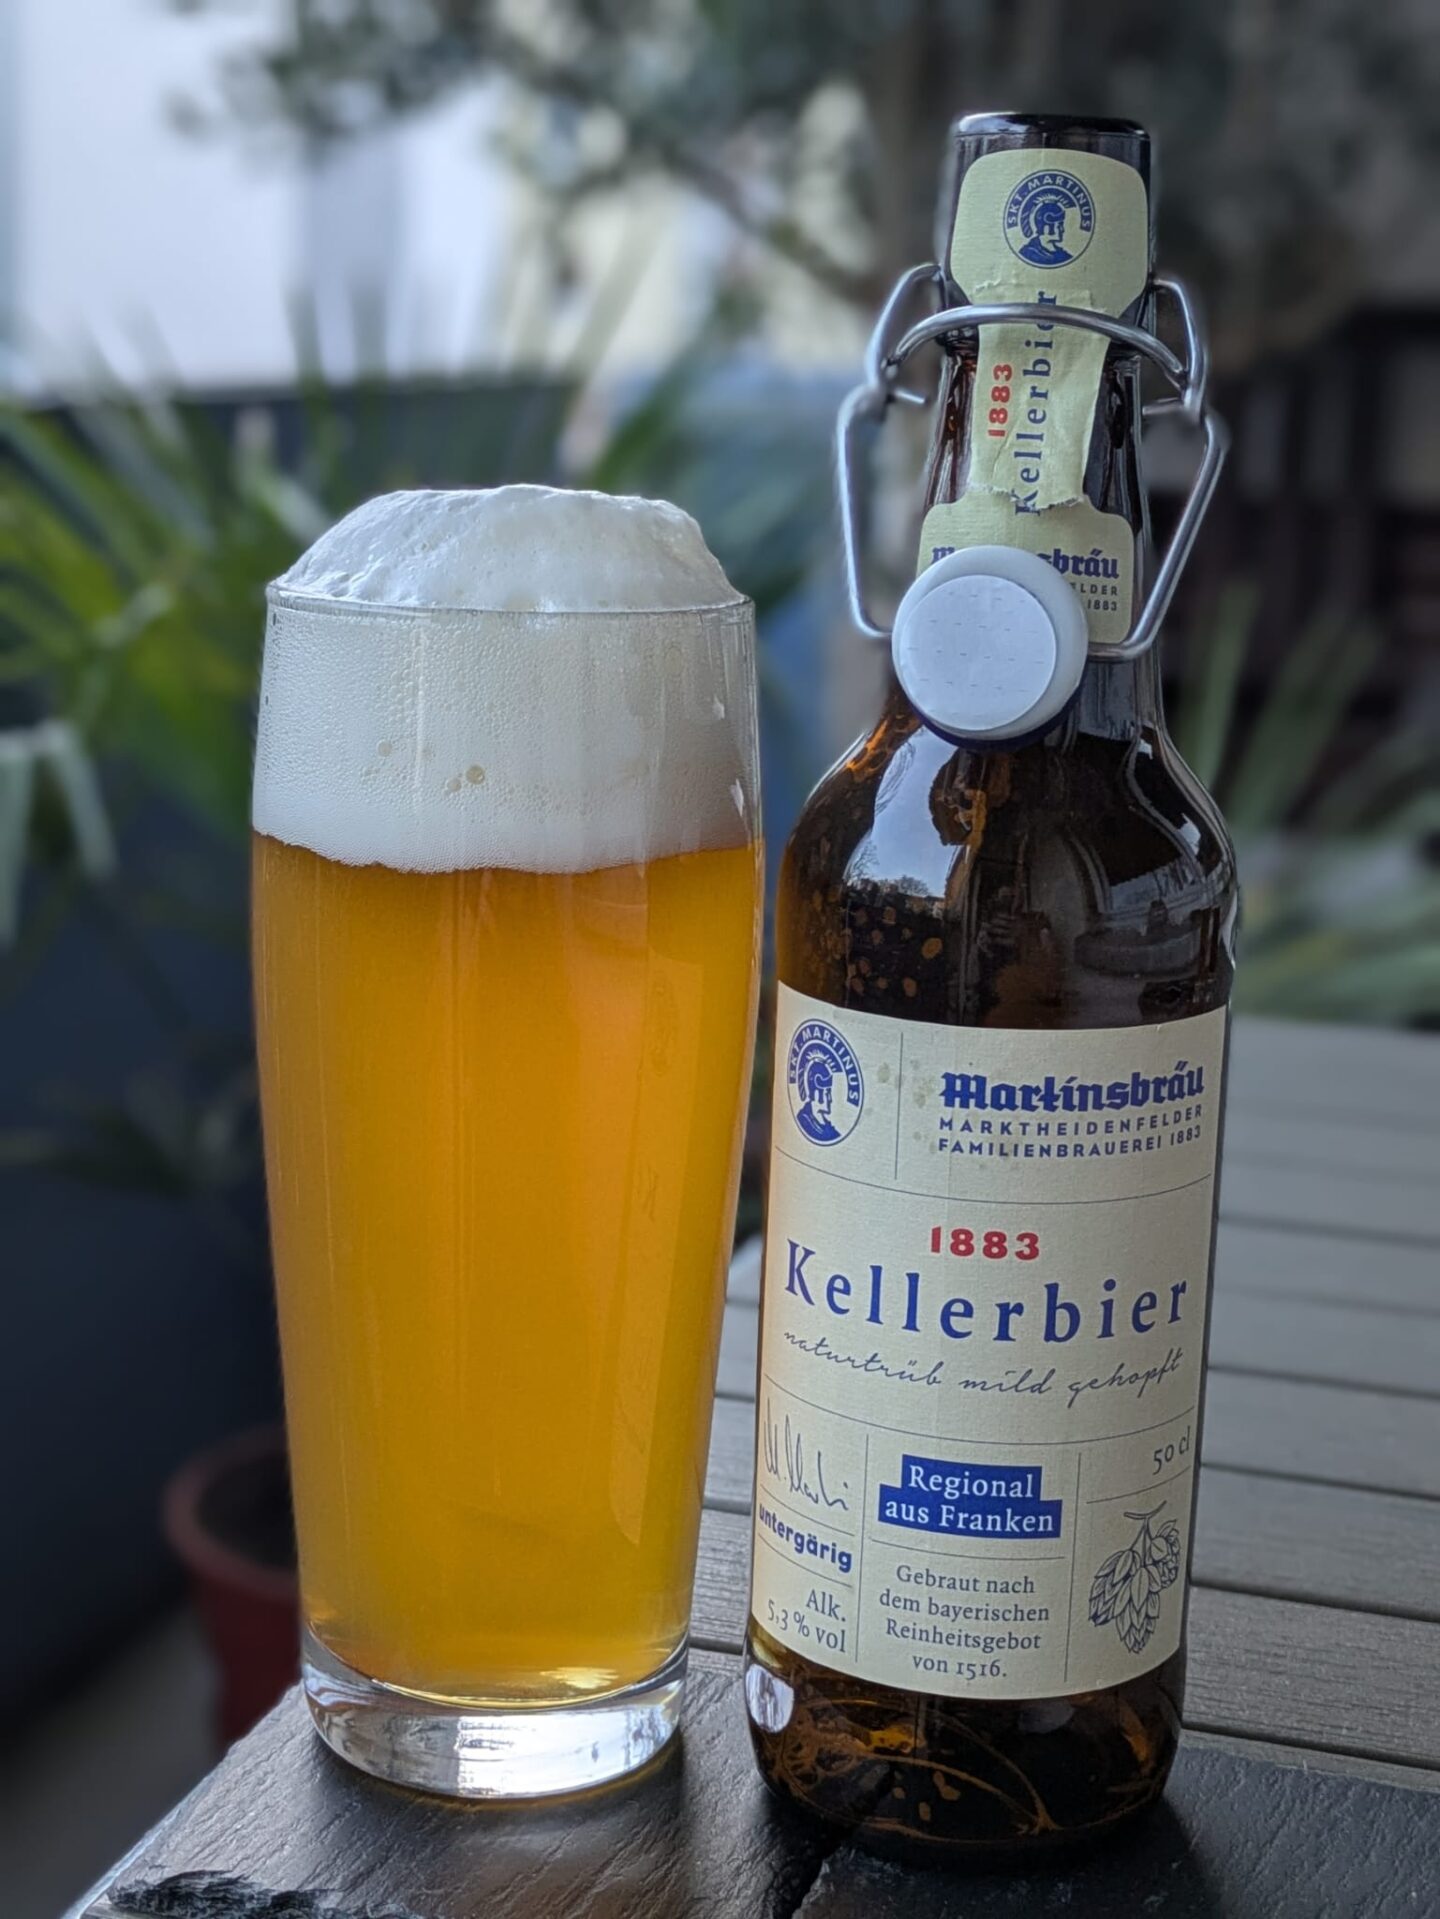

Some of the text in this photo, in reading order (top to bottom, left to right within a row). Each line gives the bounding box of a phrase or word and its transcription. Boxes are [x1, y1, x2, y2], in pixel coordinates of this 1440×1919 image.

[1028, 175, 1090, 227] MARTINUS
[988, 364, 1013, 437] 1883
[1087, 599, 1118, 612] 1883
[802, 1026, 859, 1100] MARTINUS
[939, 1061, 1205, 1113] Martinsbräu
[939, 1104, 1203, 1137] MARKTHEIDENFELDER
[938, 1125, 1202, 1158] FAMILIENBRAUEREI 1883
[930, 1226, 1041, 1261] 1883
[784, 1238, 1188, 1343] Kellerbier
[783, 1329, 1184, 1408] naturtrüb mild gehopft
[1152, 1425, 1191, 1475] 50 cl
[909, 1465, 1034, 1499] Regional
[885, 1500, 1054, 1533] aus Franken
[758, 1503, 853, 1574] untergärig
[896, 1564, 1036, 1595] Gebraut nach
[806, 1588, 847, 1623] Alk.
[879, 1588, 1050, 1628] dem bayerischen
[767, 1598, 846, 1653] 5,3 % vol
[885, 1618, 1042, 1652] Reinheitsgebot
[912, 1654, 1008, 1682] von 1516.
